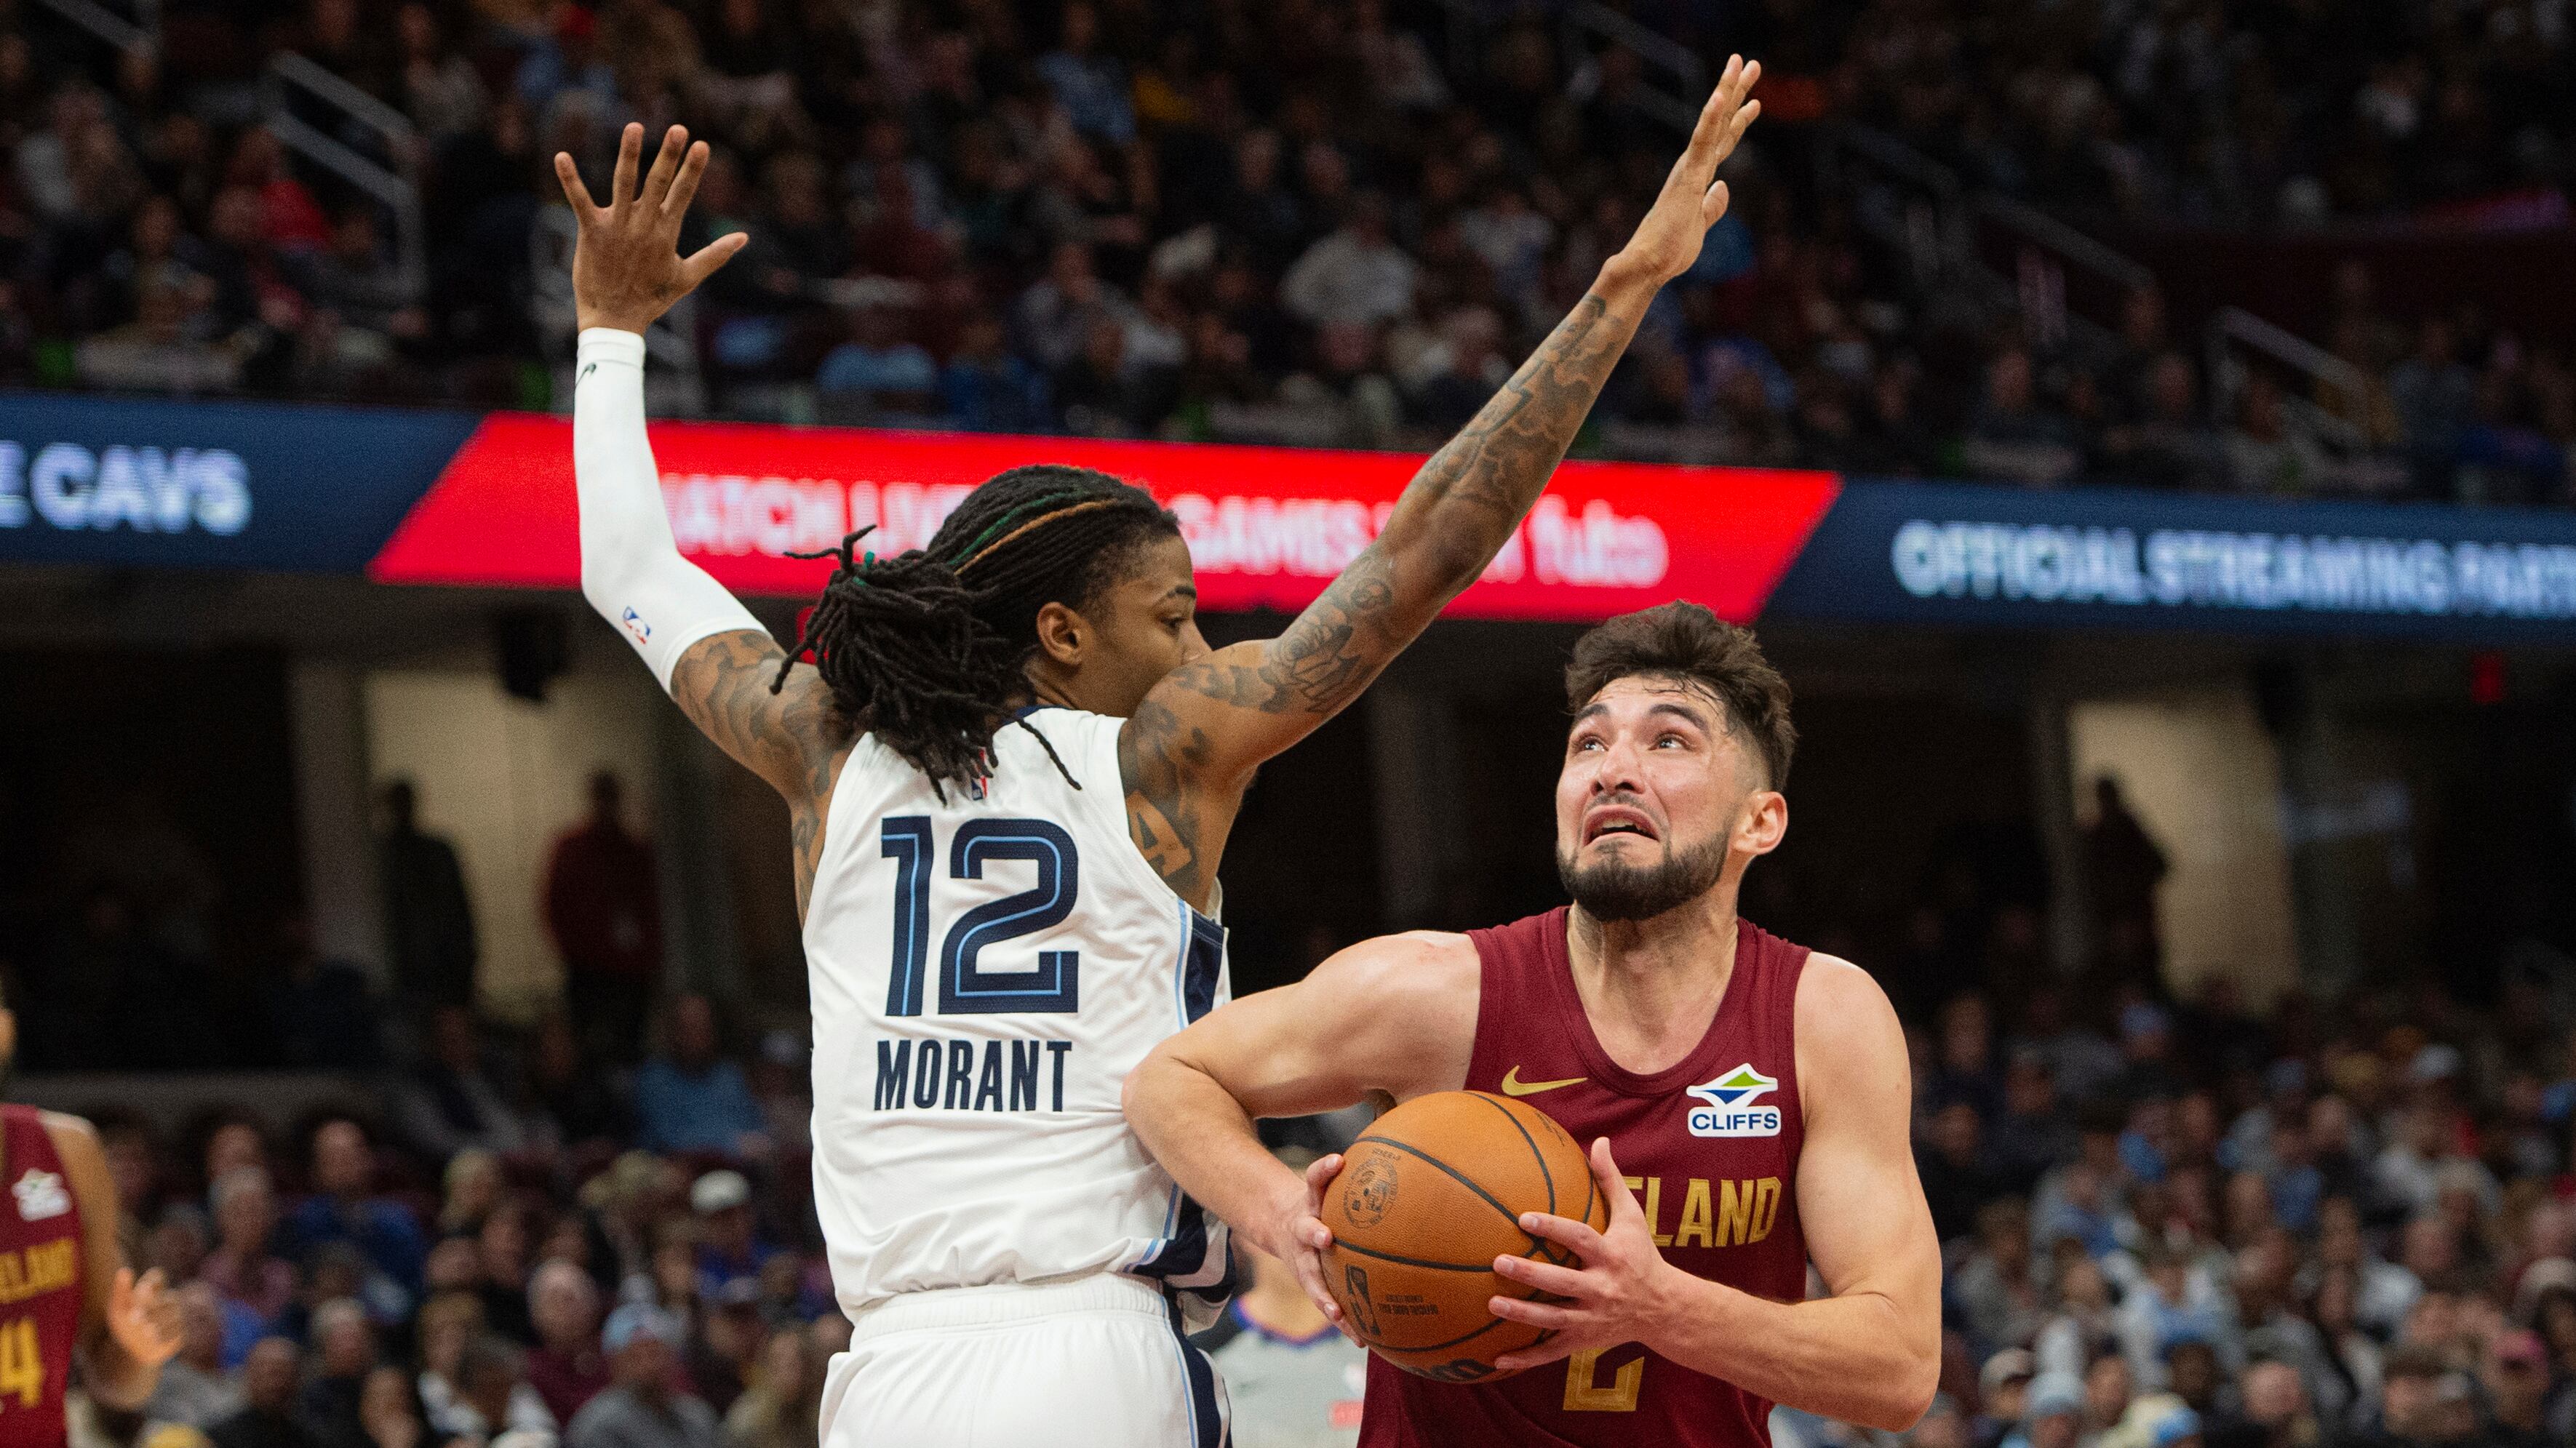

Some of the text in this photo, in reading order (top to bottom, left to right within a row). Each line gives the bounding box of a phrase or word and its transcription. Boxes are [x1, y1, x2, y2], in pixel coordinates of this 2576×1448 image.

[31, 441, 252, 536] CAVS
[1892, 520, 2148, 604] OFFICIAL
[2146, 529, 2452, 615] STREAMING
[880, 815, 1080, 1017] 12
[873, 1039, 1073, 1112] MORANT
[1691, 1112, 1779, 1130] CLIFFS
